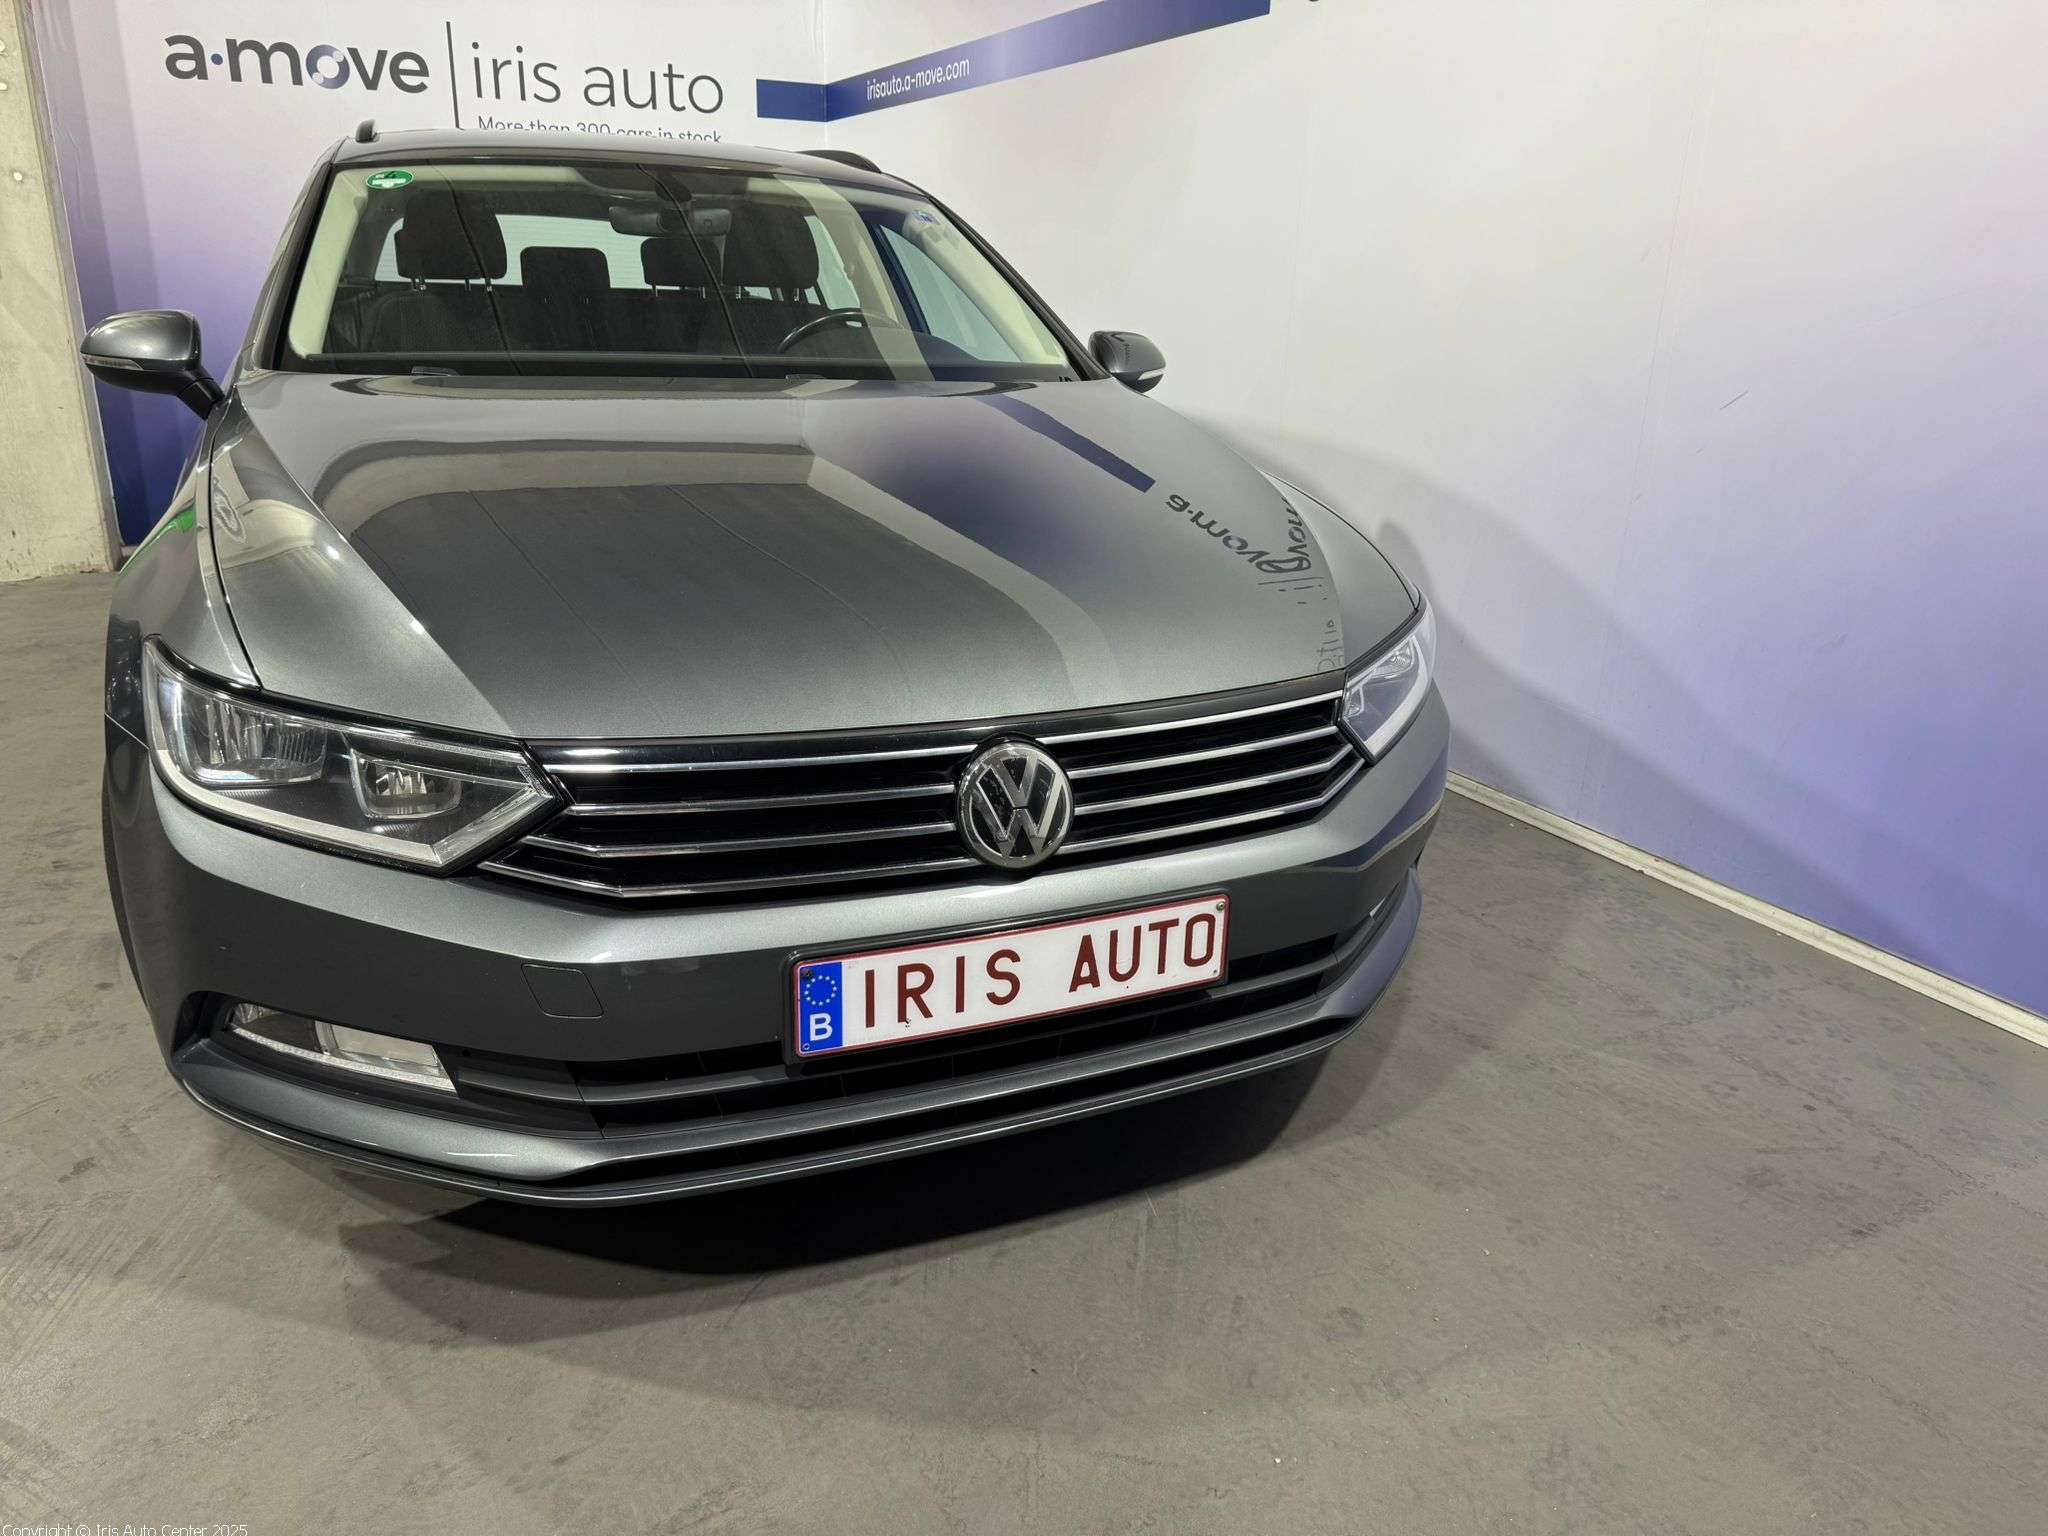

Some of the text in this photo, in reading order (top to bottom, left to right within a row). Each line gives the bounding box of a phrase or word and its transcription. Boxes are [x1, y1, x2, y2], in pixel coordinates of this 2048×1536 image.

[471, 41, 723, 114] iris auto
[866, 59, 970, 101] irisauto.a-move.com
[864, 912, 1217, 1029] IRIS AUTO
[808, 1012, 834, 1042] B
